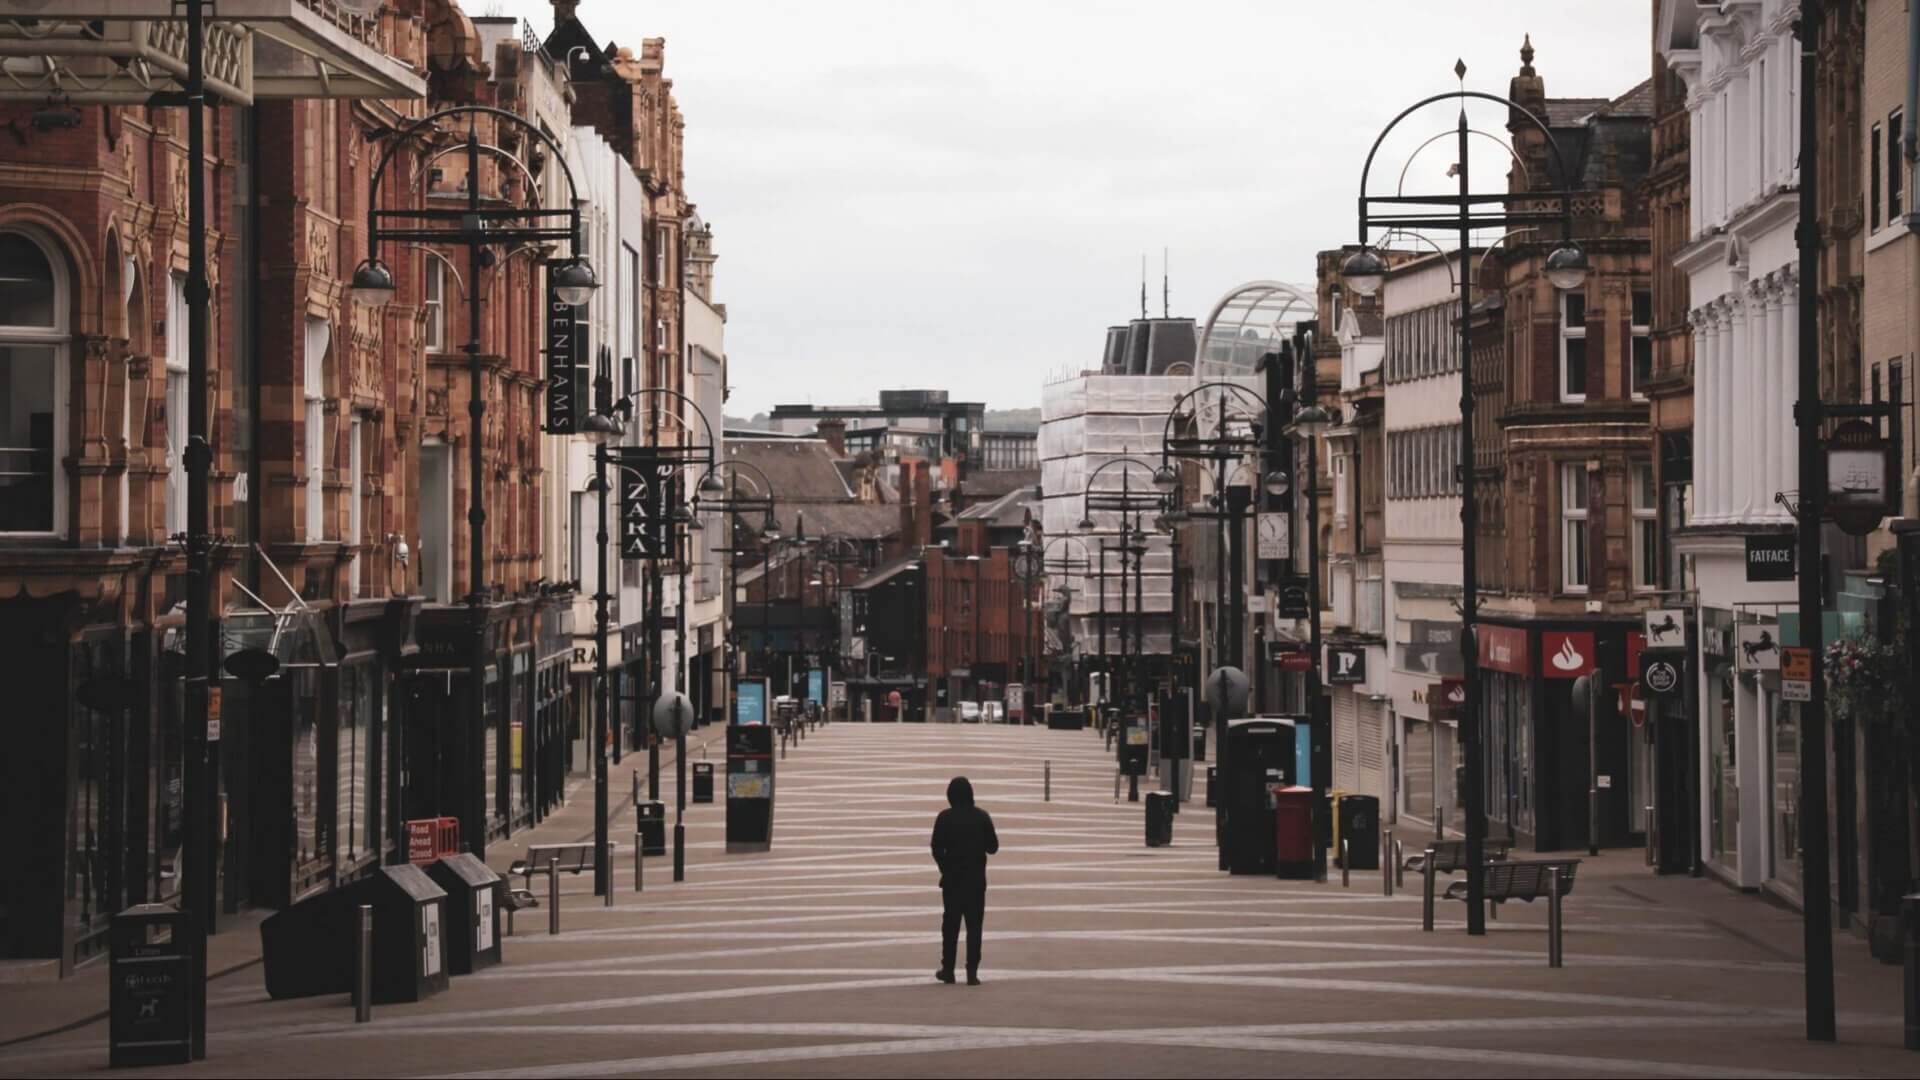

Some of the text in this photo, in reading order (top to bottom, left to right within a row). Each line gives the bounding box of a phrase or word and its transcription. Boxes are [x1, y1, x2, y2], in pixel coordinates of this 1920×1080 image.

[626, 483, 649, 553] ZARA
[1750, 550, 1790, 563] FATFACE
[411, 824, 429, 834] Road
[410, 836, 432, 846] Ahead
[409, 848, 432, 859] Closed
